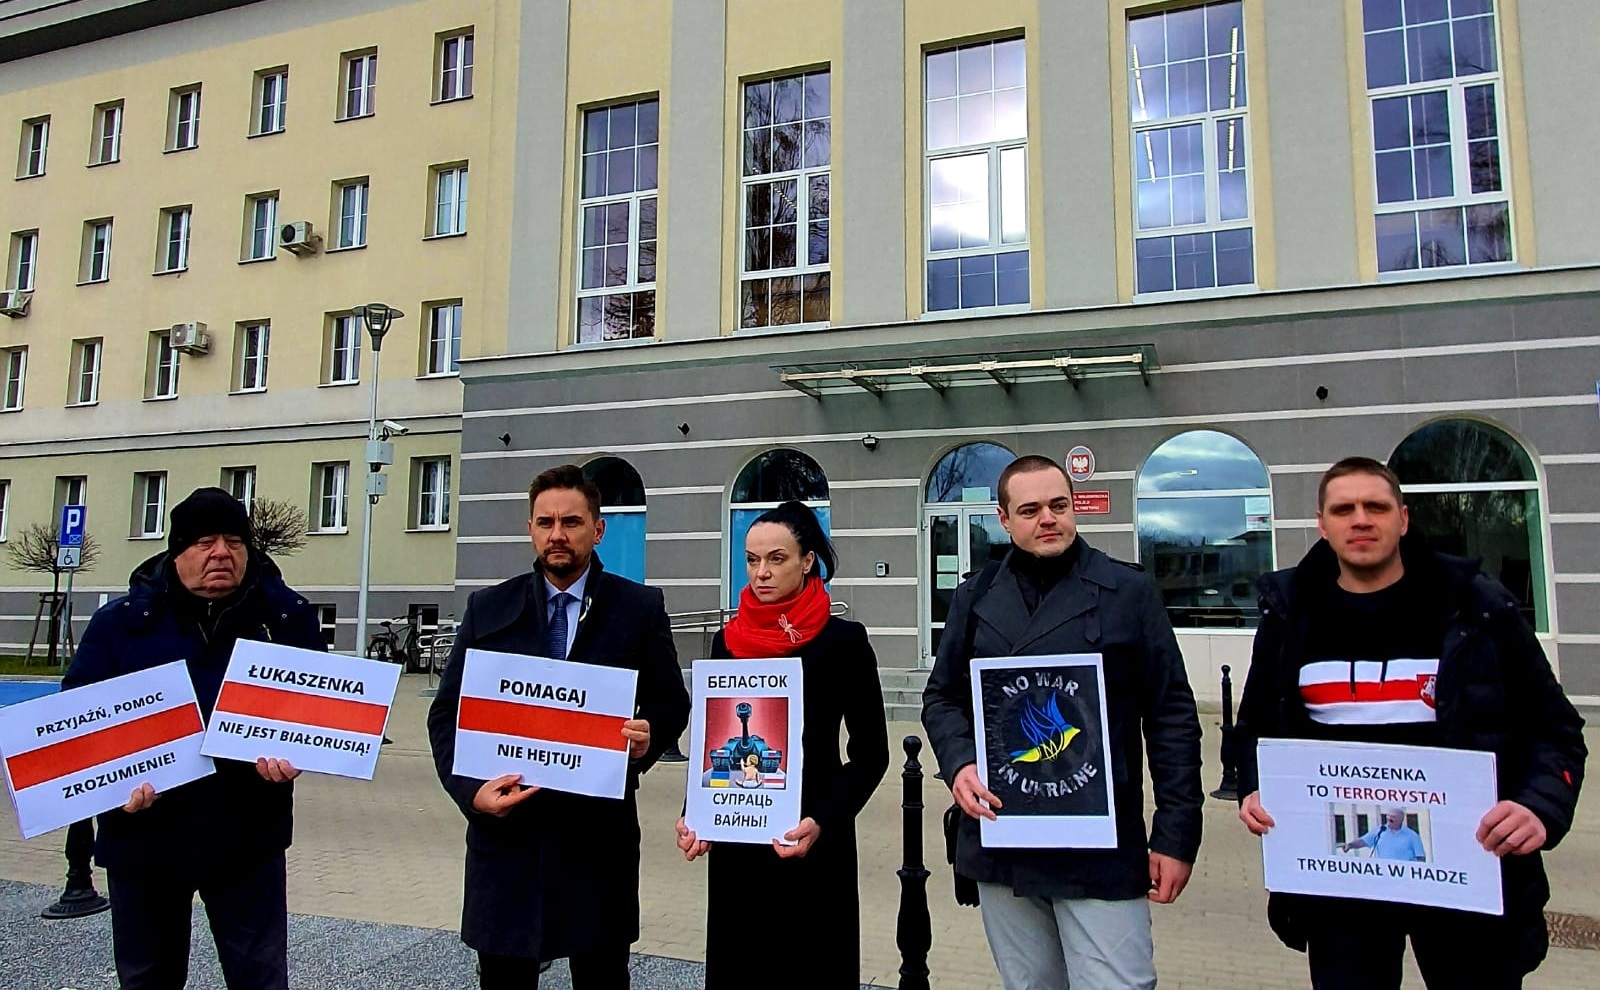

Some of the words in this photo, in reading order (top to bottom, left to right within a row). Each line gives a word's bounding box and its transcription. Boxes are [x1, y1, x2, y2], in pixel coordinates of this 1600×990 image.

[66, 509, 80, 534] P
[248, 664, 365, 695] ŁUKASZENKA
[707, 675, 788, 689] БЕЛАСТОК
[1002, 675, 1029, 698] NO
[1035, 672, 1080, 697] WAR
[499, 679, 586, 708] POMAGAJ
[36, 706, 111, 737] PRZYJAŹŃ,
[113, 692, 164, 714] POMOC
[218, 721, 244, 735] NIE
[243, 725, 277, 740] JEST
[279, 730, 371, 757] BIAŁORUSIĄ!
[497, 744, 523, 759] NIE
[526, 749, 582, 769] HEJTUJ!
[62, 752, 176, 799] ZROZUMIENIE!
[998, 763, 1020, 785] IN
[1020, 762, 1098, 798] UKRAINE
[1319, 764, 1426, 782] ŁUKASZENKA
[712, 793, 773, 808] СУПРАЦЬ
[1307, 784, 1329, 798] TO
[1333, 786, 1447, 805] TERRORYSTA!
[714, 812, 767, 828] ВАЙНЫ!
[1297, 858, 1383, 876] TRYBUNAŁ
[1389, 865, 1405, 878] W
[1411, 867, 1468, 885] HADZE
